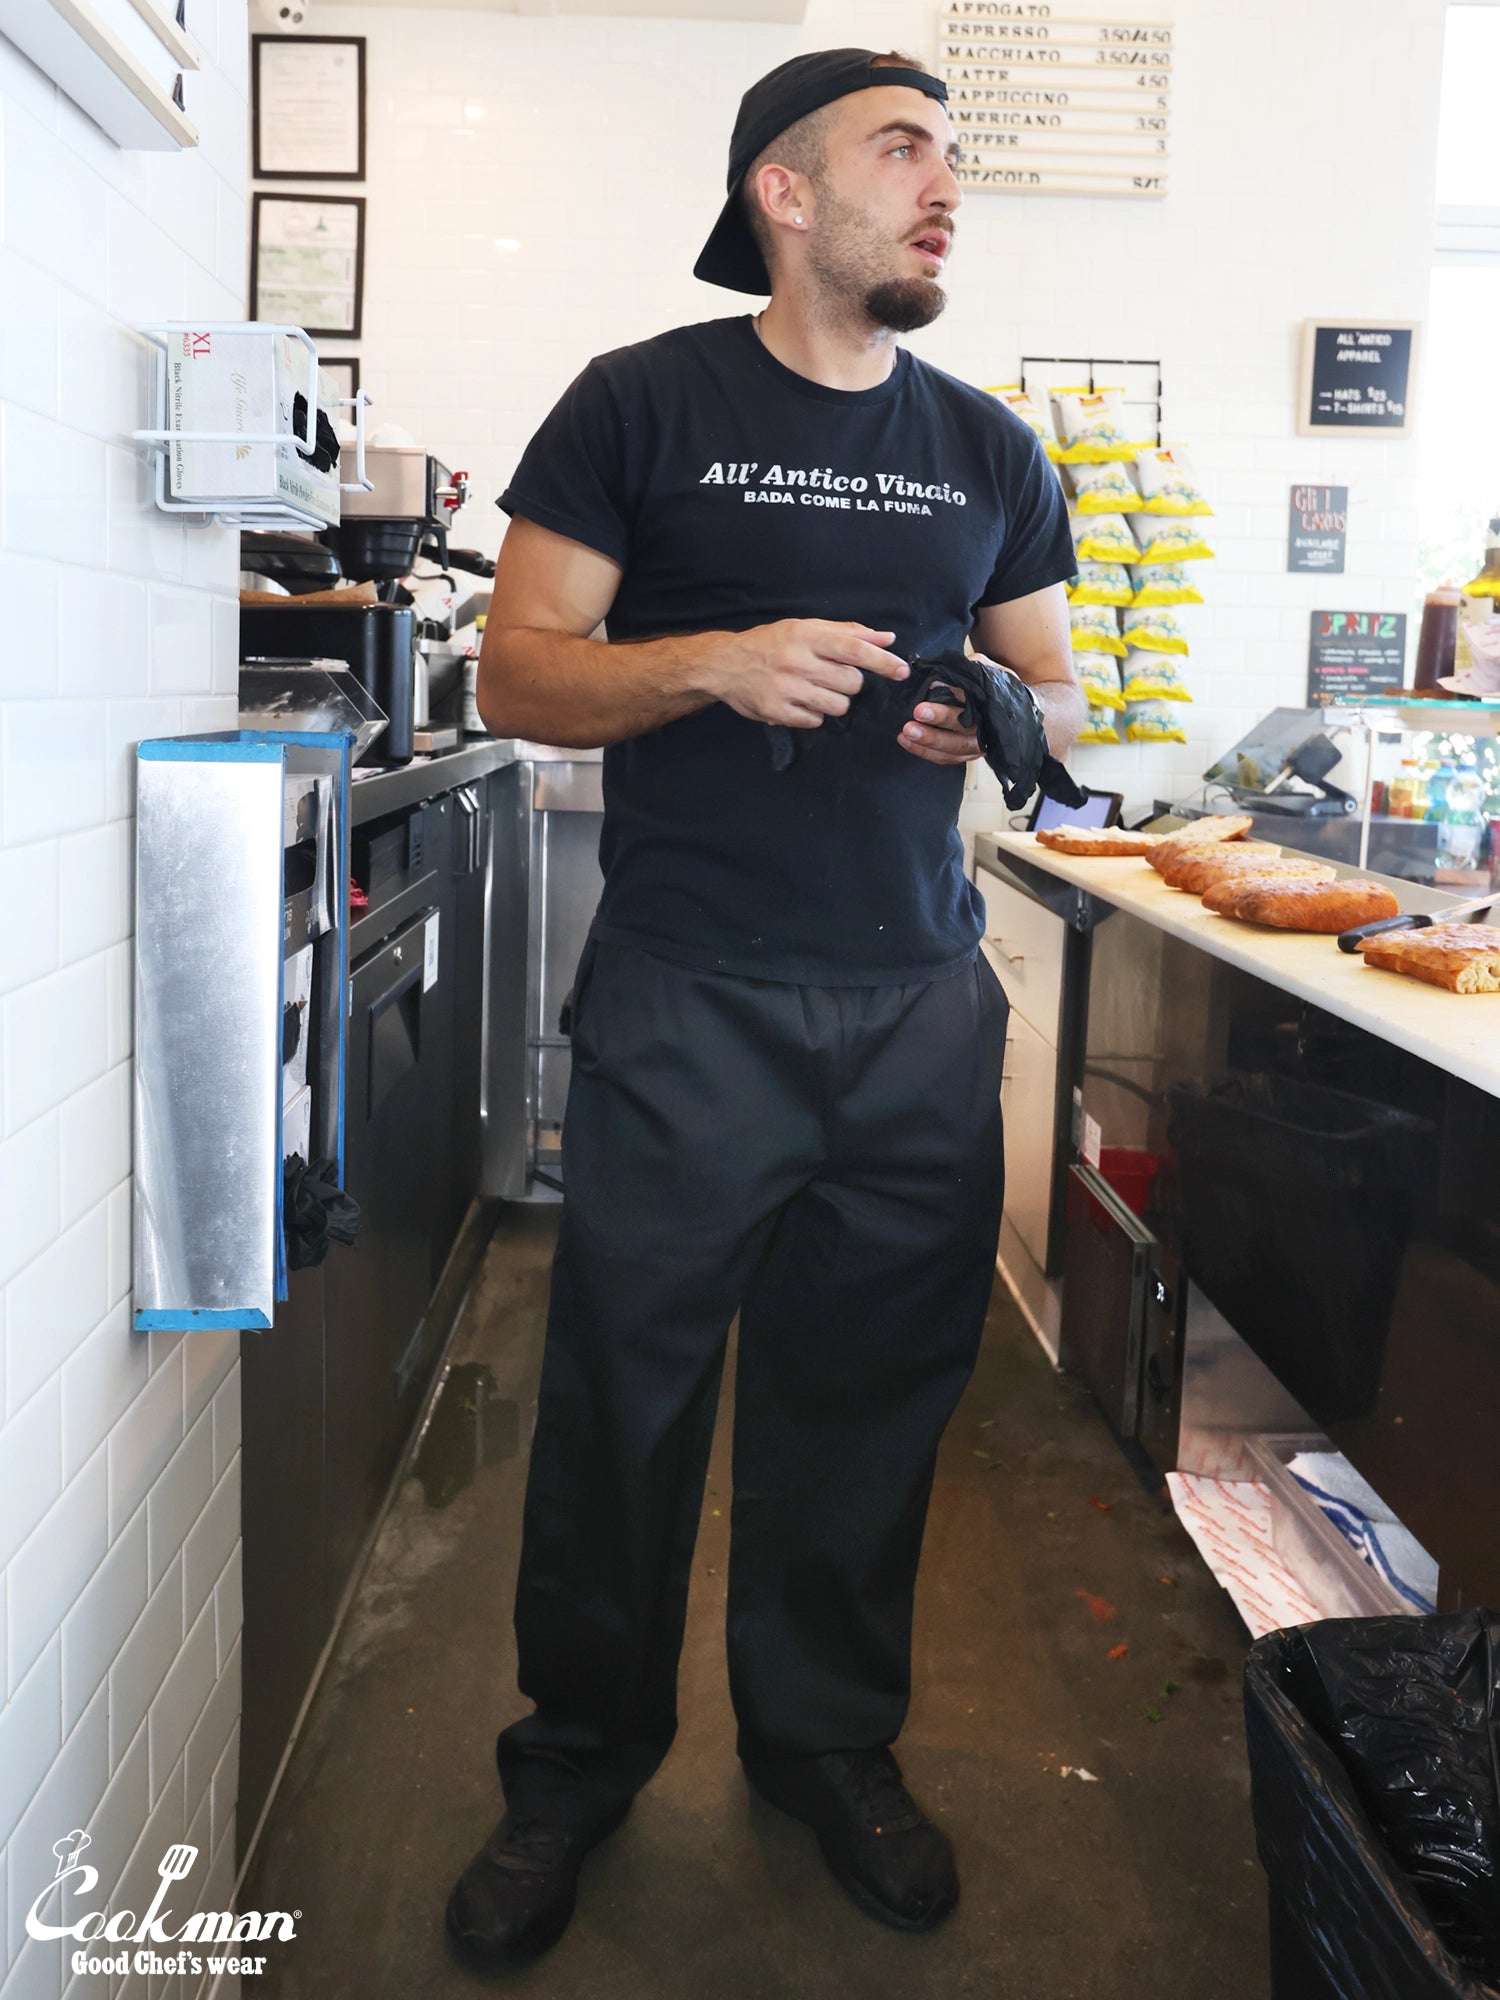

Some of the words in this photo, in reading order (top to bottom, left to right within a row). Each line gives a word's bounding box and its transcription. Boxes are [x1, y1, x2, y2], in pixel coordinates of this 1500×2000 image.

[950, 2, 1051, 17] AFFOGATO
[948, 23, 1049, 39] ESPRESSO
[947, 46, 1061, 62] MACCHIATO
[946, 68, 1009, 82] LATTE
[1156, 95, 1167, 109] 5
[957, 132, 1019, 146] OFFEE
[1156, 140, 1166, 153] 3
[955, 168, 1041, 185] OT/COLD
[193, 332, 211, 359] XL
[173, 362, 182, 384] Black
[174, 386, 183, 411] Nitrile
[1334, 388, 1361, 402] HATS
[175, 413, 184, 462] Exaation
[176, 464, 184, 490] Gloves
[760, 464, 868, 493] Antico
[875, 473, 967, 507] Vinaio
[744, 491, 795, 505] BADA
[800, 492, 851, 509] COME
[856, 499, 880, 512] LA
[885, 500, 933, 517] FUMA
[1293, 486, 1331, 512] GIFT
[1318, 613, 1397, 638] SPRITZ
